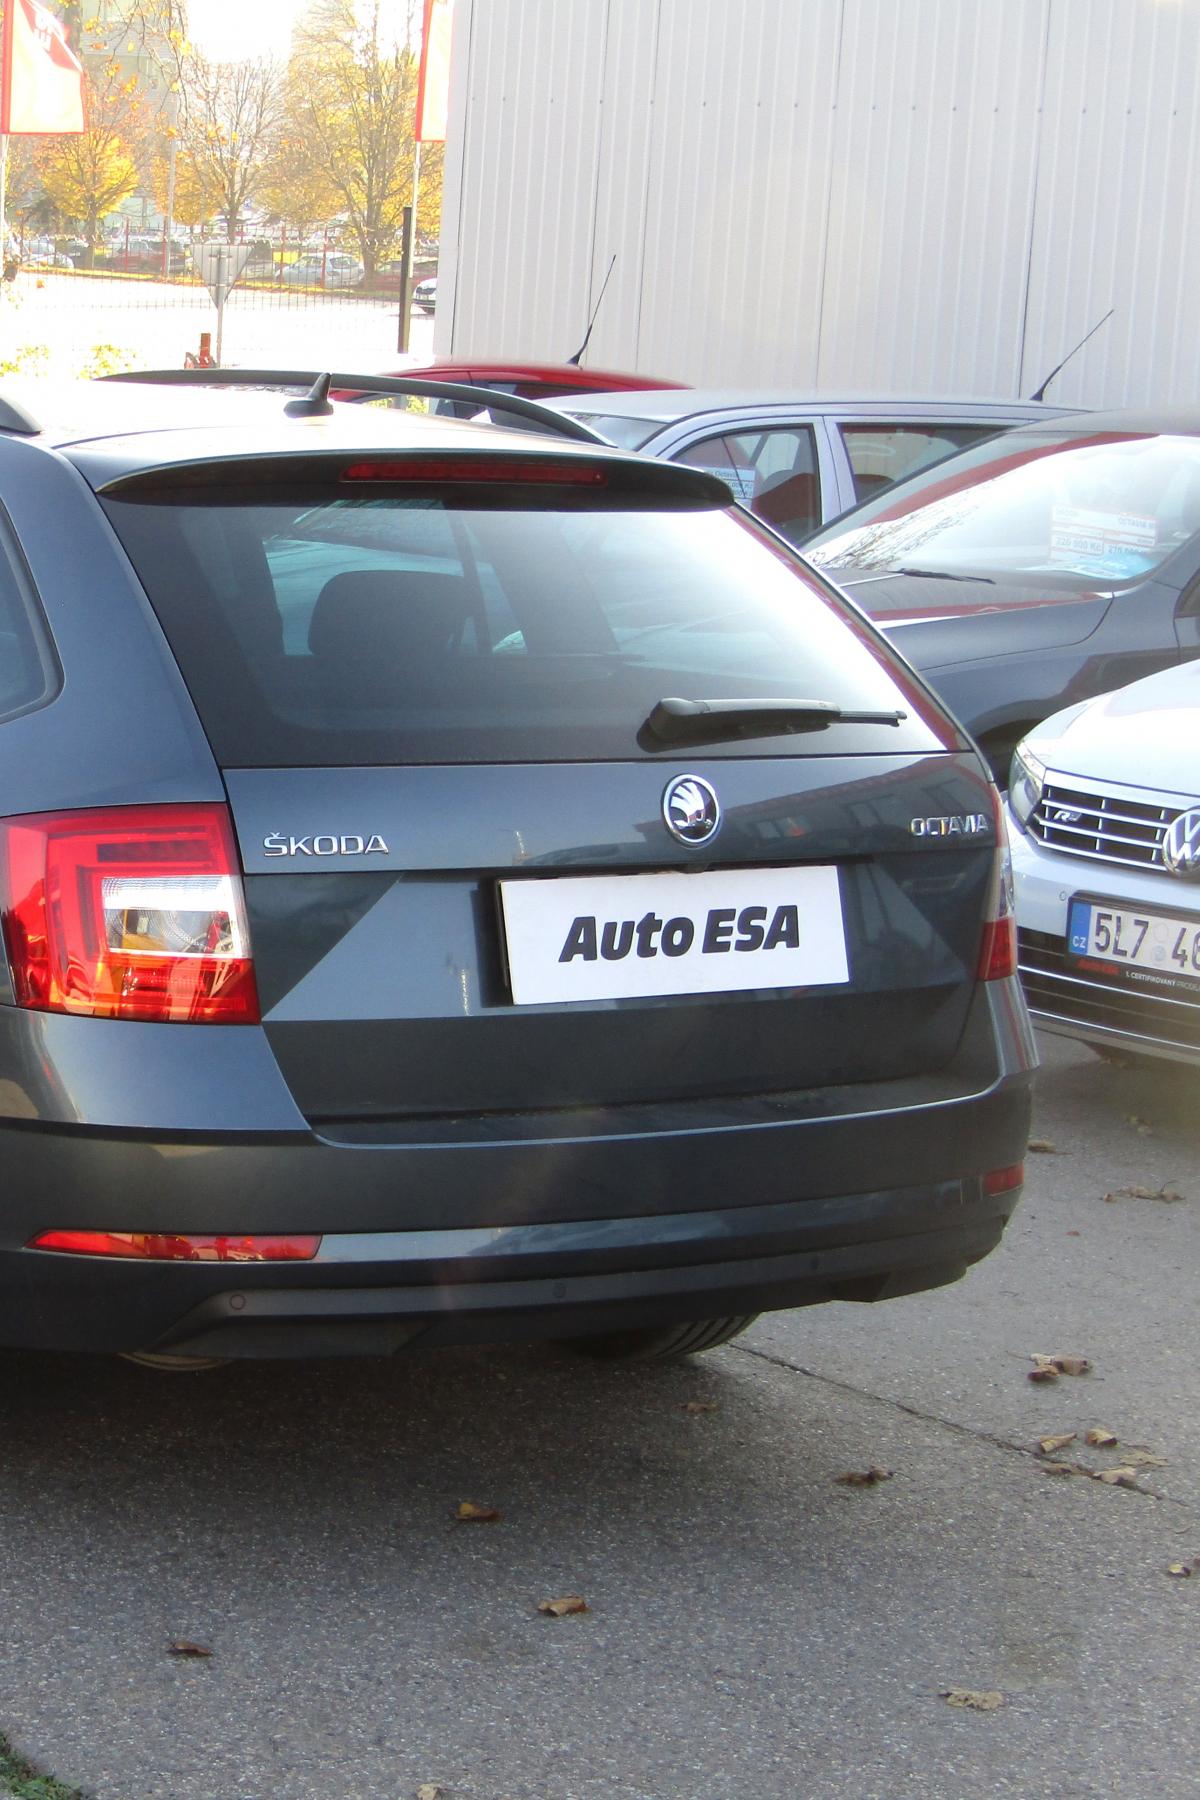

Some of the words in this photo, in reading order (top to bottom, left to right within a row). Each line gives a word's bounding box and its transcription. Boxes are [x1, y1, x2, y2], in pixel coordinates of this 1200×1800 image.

[910, 813, 989, 836] OCTAVIA
[263, 831, 390, 856] ŠKODA
[558, 912, 695, 963] Auto
[701, 904, 800, 954] ESA
[1072, 935, 1087, 949] CZ
[1094, 912, 1150, 960] 5L7
